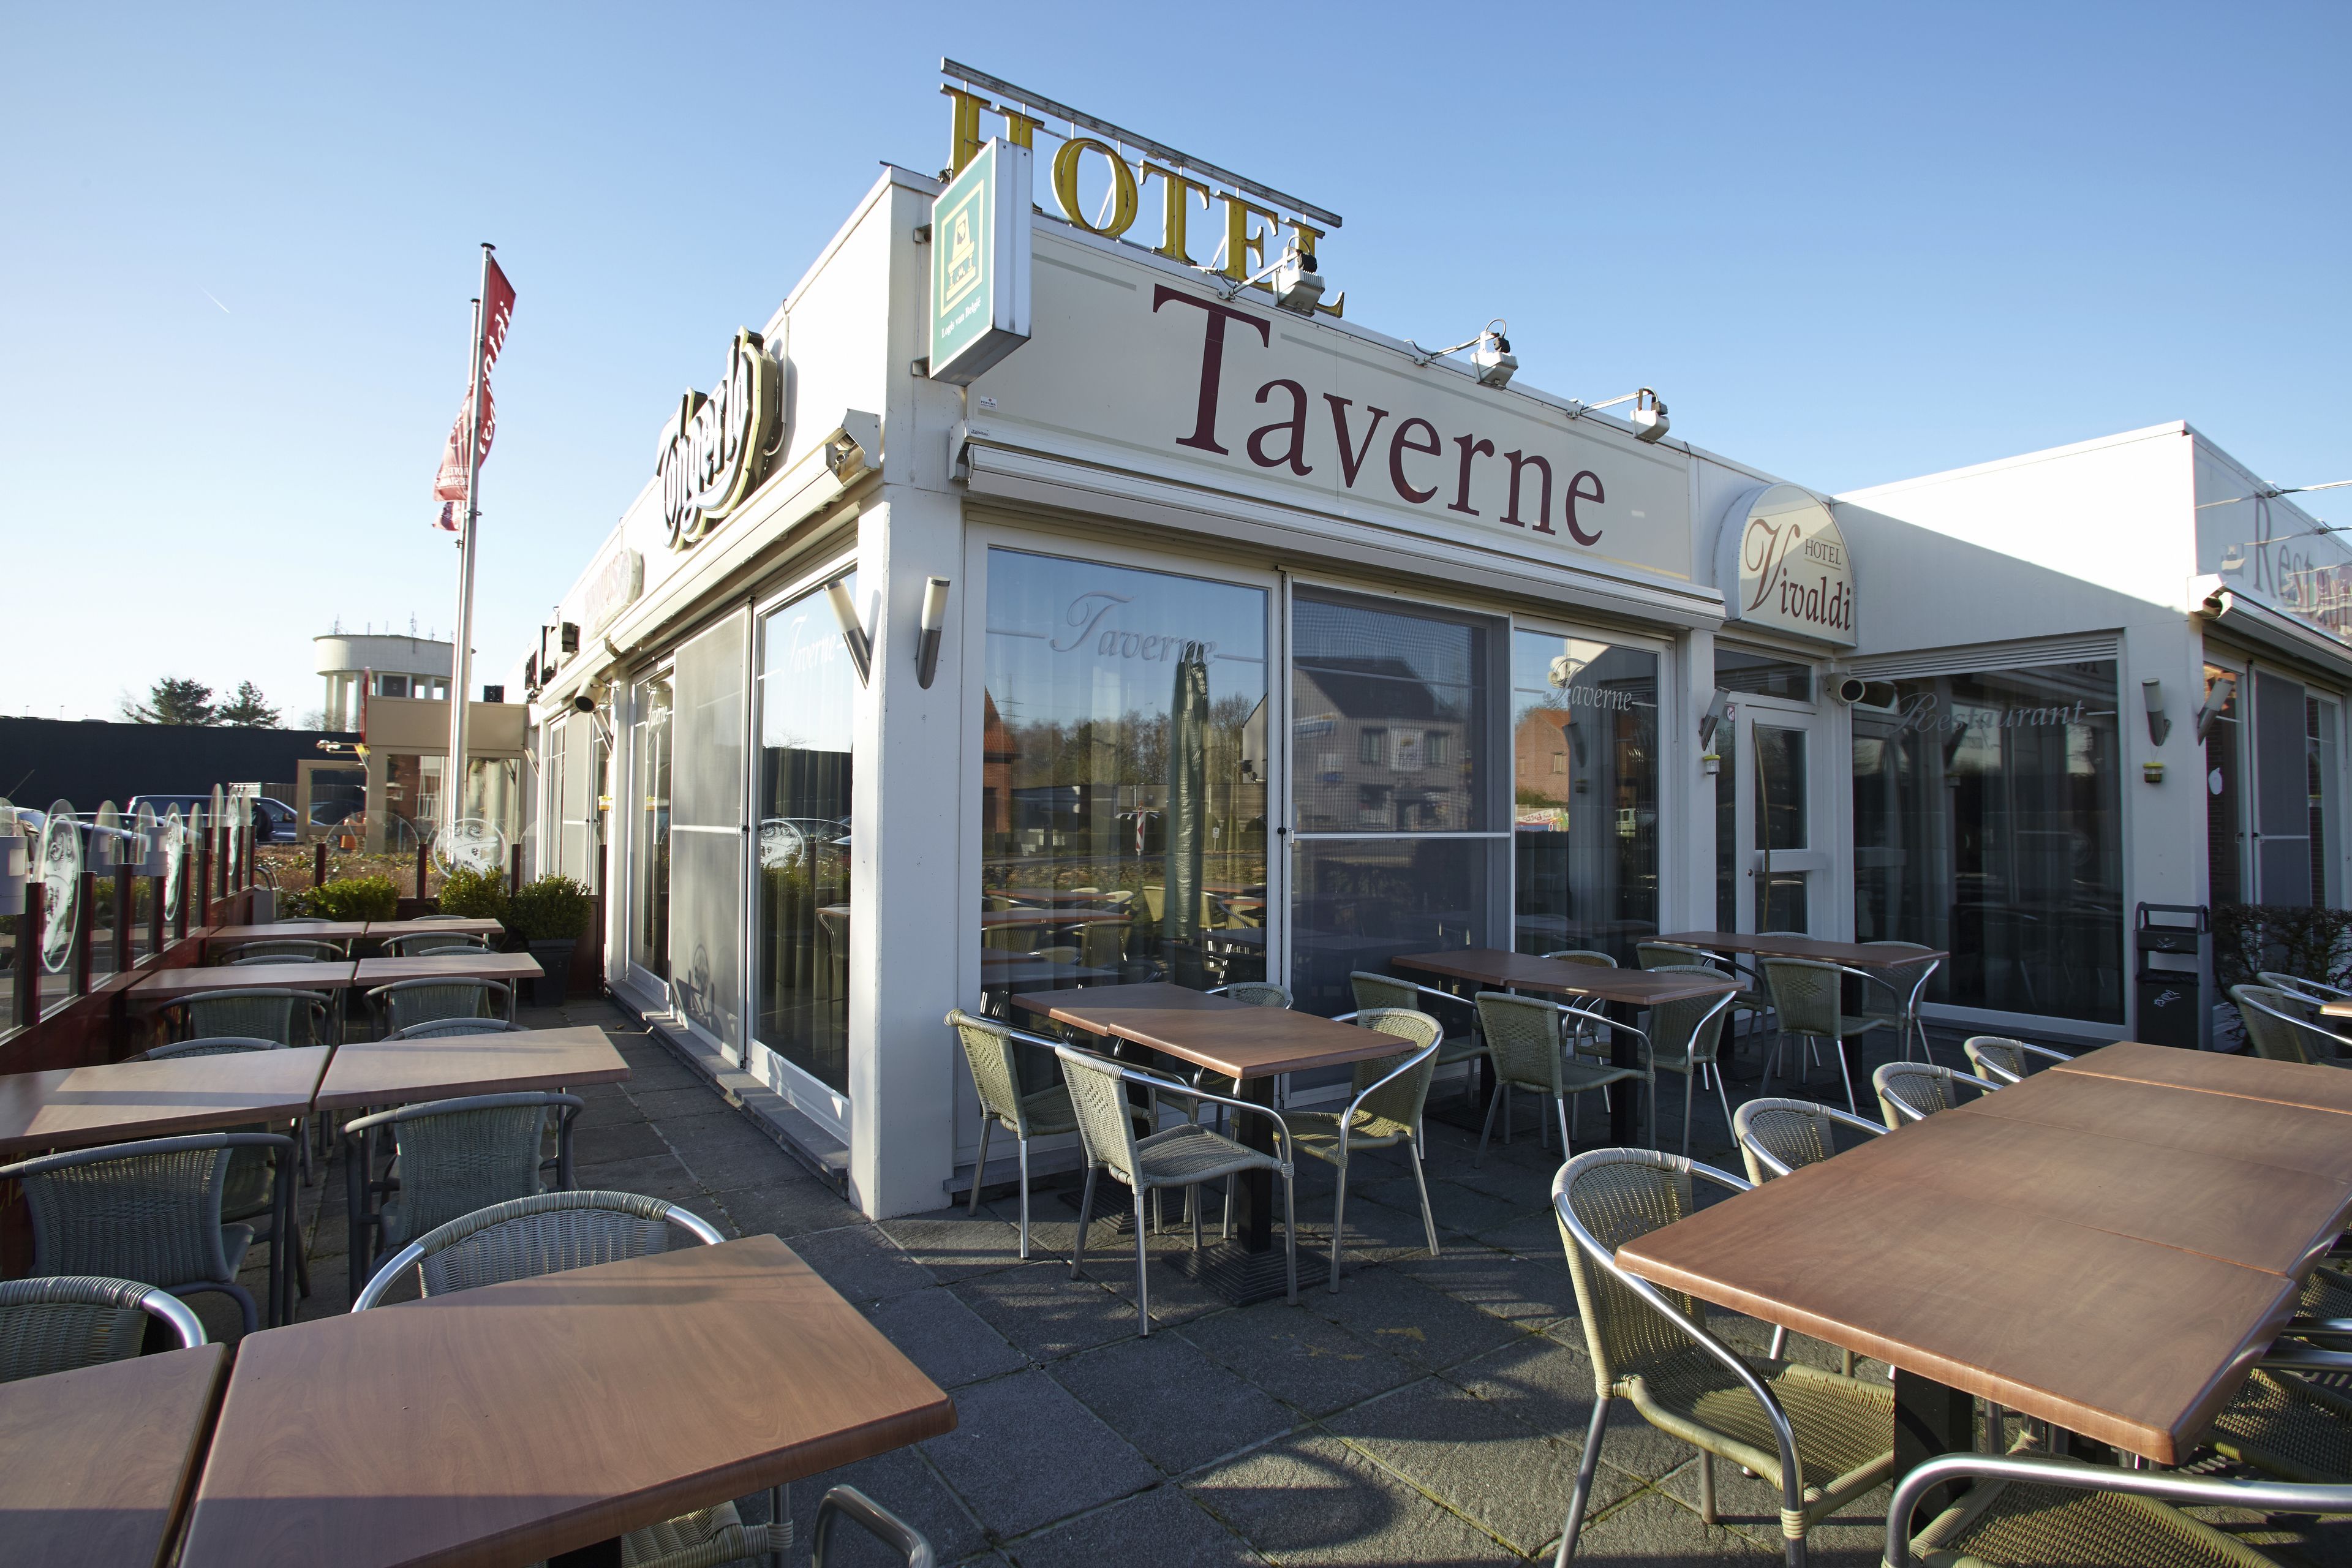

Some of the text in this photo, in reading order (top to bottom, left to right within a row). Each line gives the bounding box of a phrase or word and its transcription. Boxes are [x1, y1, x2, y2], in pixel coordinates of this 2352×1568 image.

[1153, 282, 1606, 547] Taverne
[1745, 518, 1851, 631] Vivaldi
[1804, 538, 1842, 565] HOTEL
[1050, 590, 1219, 666] Taverne
[1543, 657, 1632, 711] Taverne
[1885, 692, 2086, 733] Restaurant
